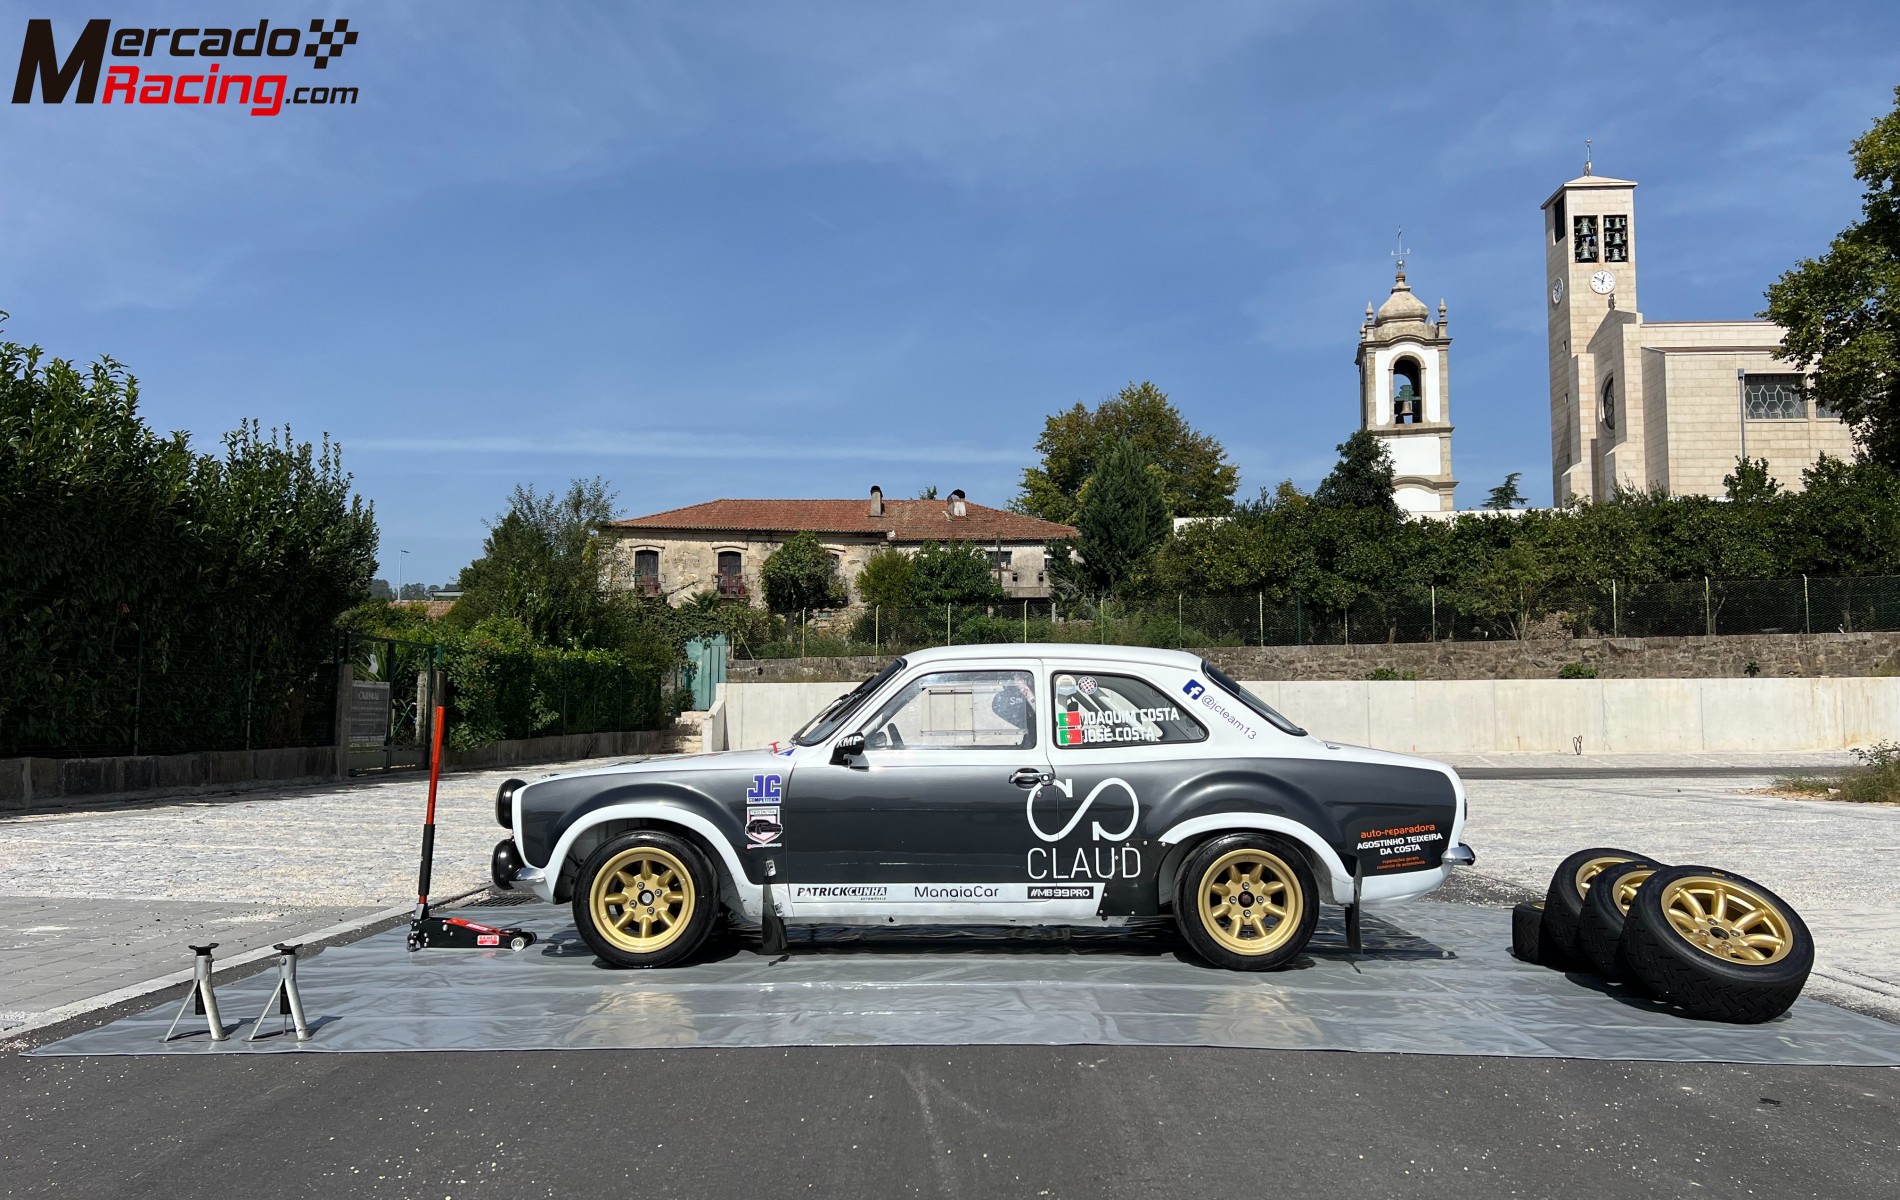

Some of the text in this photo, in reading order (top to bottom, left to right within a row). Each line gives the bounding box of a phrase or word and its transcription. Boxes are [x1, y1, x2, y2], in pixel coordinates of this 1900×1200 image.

[1082, 707, 1180, 725] JOAQUIM COSTA
[1202, 694, 1257, 740] @jcteam13
[1115, 727, 1155, 741] COSTA
[748, 775, 781, 797] JC
[1360, 823, 1436, 839] auto-reparadora
[1356, 833, 1443, 850] AGOSTINHO TEIXEIRA
[1394, 844, 1421, 853] COSTA
[1027, 847, 1141, 880] CLAUD
[914, 886, 999, 898] ManaiaCar
